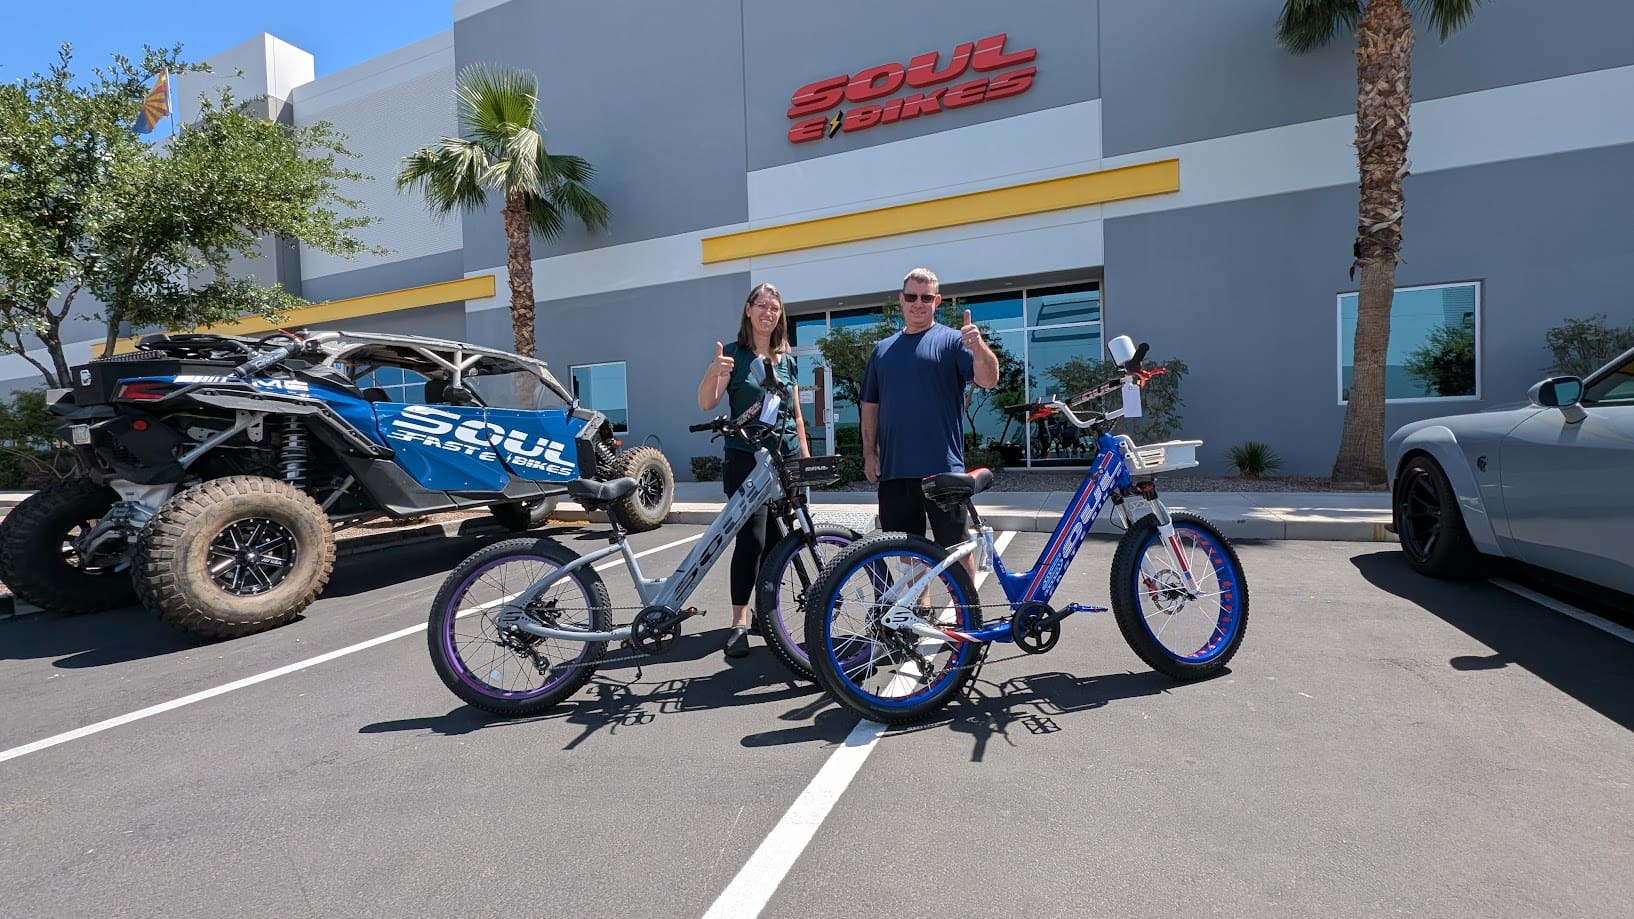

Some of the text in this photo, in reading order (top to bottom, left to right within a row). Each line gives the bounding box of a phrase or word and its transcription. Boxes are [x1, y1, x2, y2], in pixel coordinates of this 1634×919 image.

[786, 33, 1037, 118] SOUL
[387, 429, 480, 455] FAST
[391, 405, 576, 467] SOUL
[674, 478, 772, 603] SOUL
[1043, 461, 1122, 597] SOUL
